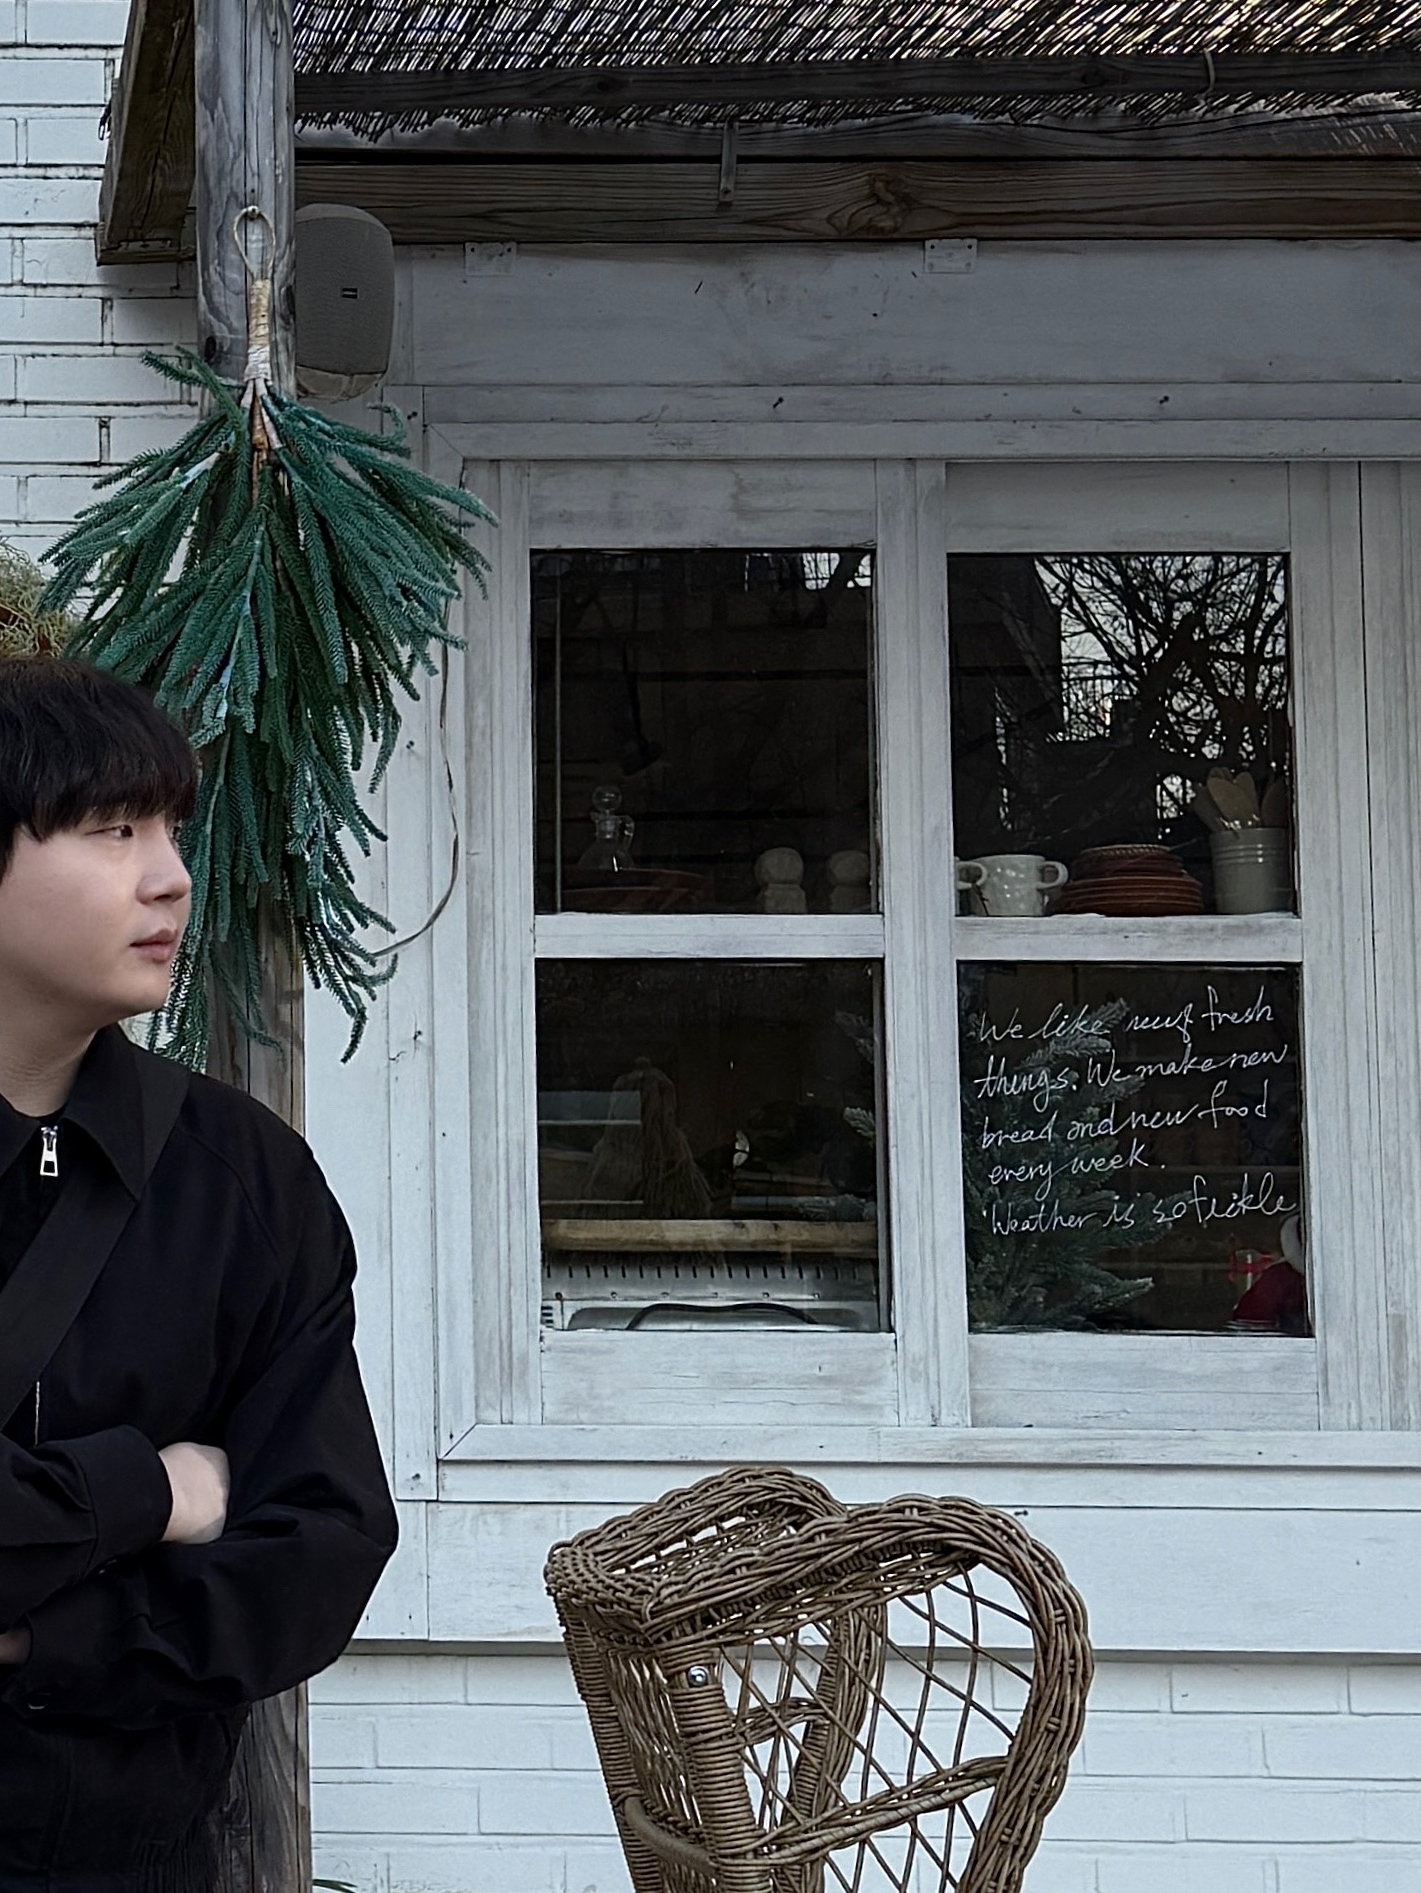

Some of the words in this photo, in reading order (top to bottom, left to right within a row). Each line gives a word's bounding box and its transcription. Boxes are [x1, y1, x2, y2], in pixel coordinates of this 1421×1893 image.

[980, 1008, 1024, 1042] We
[1030, 1002, 1111, 1040] like
[1201, 984, 1274, 1031] fresh
[974, 1055, 1078, 1113] things.
[1087, 1049, 1130, 1087] We
[1135, 1043, 1218, 1078] make
[1229, 1044, 1288, 1068] new
[981, 1110, 1059, 1149] bread
[1067, 1100, 1118, 1141] and
[1131, 1106, 1193, 1130] new
[1197, 1079, 1269, 1129] food
[988, 1161, 1053, 1201] every
[988, 1199, 1098, 1236] Weather
[1103, 1194, 1137, 1230] is
[1153, 1199, 1187, 1223] so
